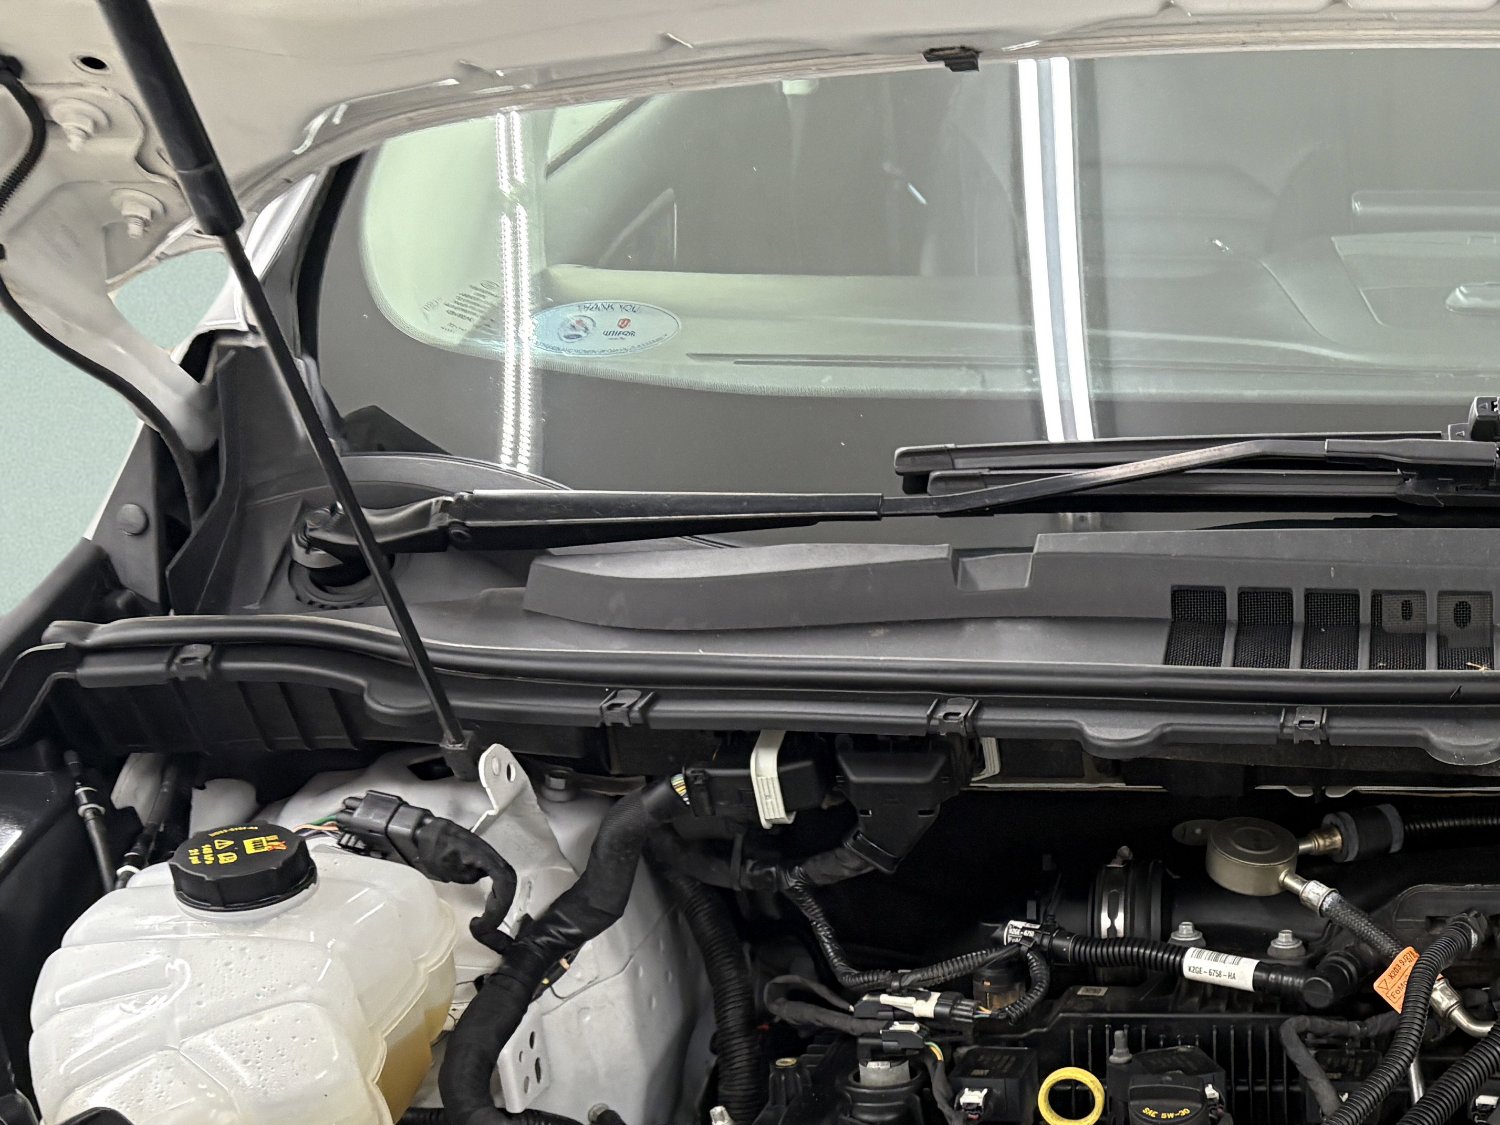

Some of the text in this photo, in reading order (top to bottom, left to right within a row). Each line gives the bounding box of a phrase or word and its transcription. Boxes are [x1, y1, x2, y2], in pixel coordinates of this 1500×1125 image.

[620, 303, 641, 313] YOU
[1142, 1107, 1190, 1119] SAE 5W-30
